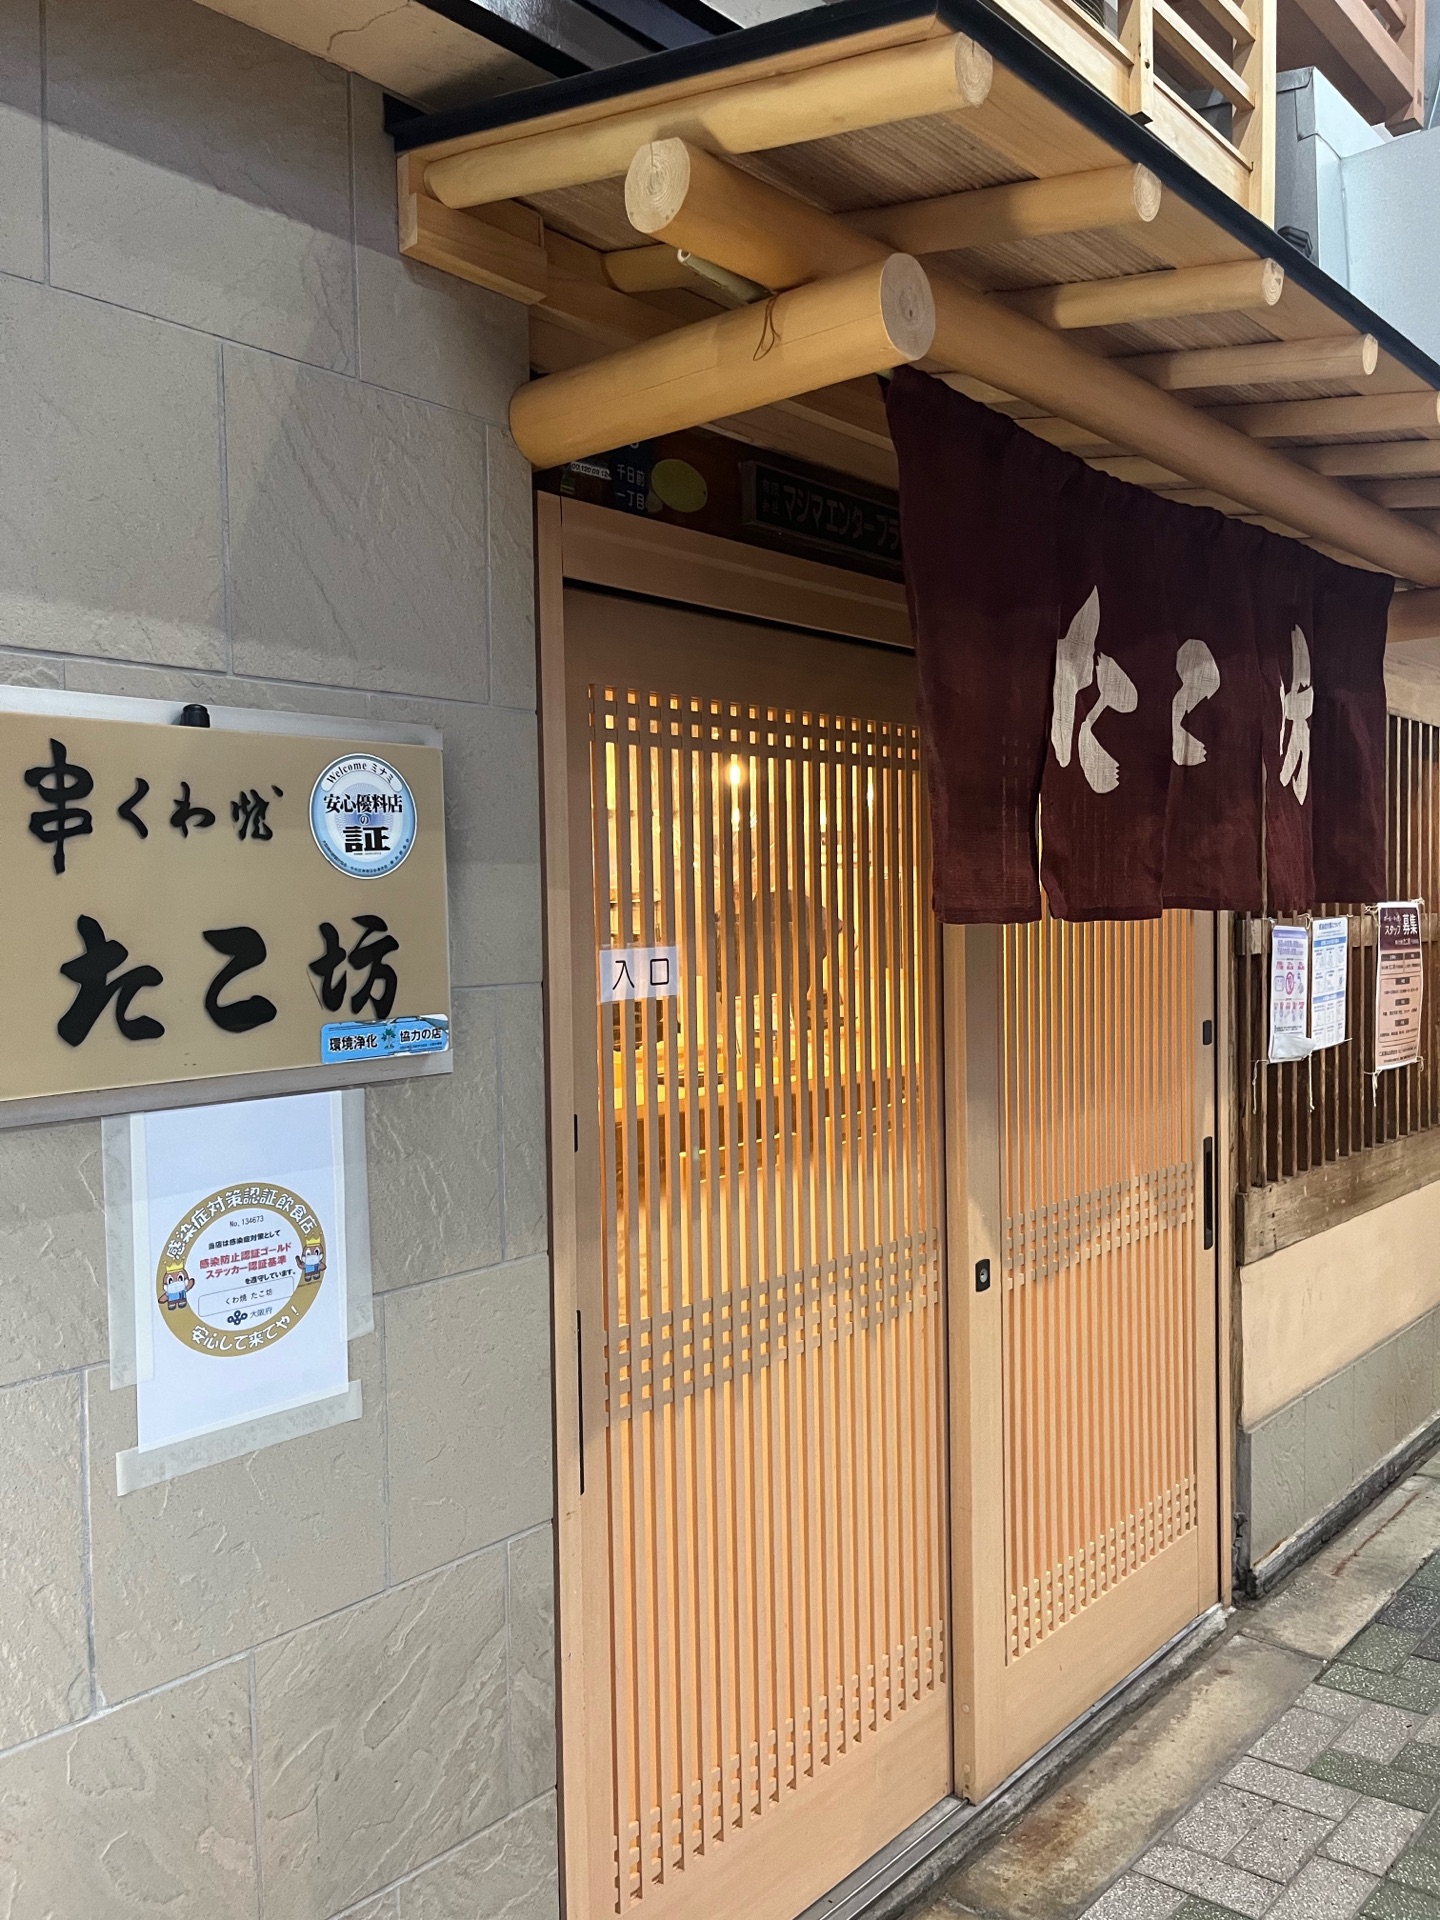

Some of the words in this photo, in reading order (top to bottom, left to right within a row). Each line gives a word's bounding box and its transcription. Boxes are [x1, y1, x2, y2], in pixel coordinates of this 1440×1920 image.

[617, 464, 645, 487] 千日前
[617, 490, 645, 510] 一丁目
[326, 762, 367, 784] Welcome
[370, 763, 395, 784] ミナミ
[360, 816, 369, 825] の
[343, 826, 391, 852] 証
[57, 914, 400, 1047] たこ坊
[612, 958, 670, 990] 入口
[329, 1033, 378, 1051] 環境浄化
[400, 1028, 441, 1042] 協力の店
[167, 1187, 318, 1260] 感染症対策認証飲食店
[229, 1220, 240, 1228] No.
[208, 1230, 281, 1250] 当店は感染症対策として
[199, 1242, 292, 1269] 感染防止認証ゴールド
[205, 1255, 287, 1279] ステッカー認証基準
[225, 1294, 247, 1305] くわ焼
[251, 1288, 273, 1300] たこ坊
[250, 1307, 273, 1319] 大阪府
